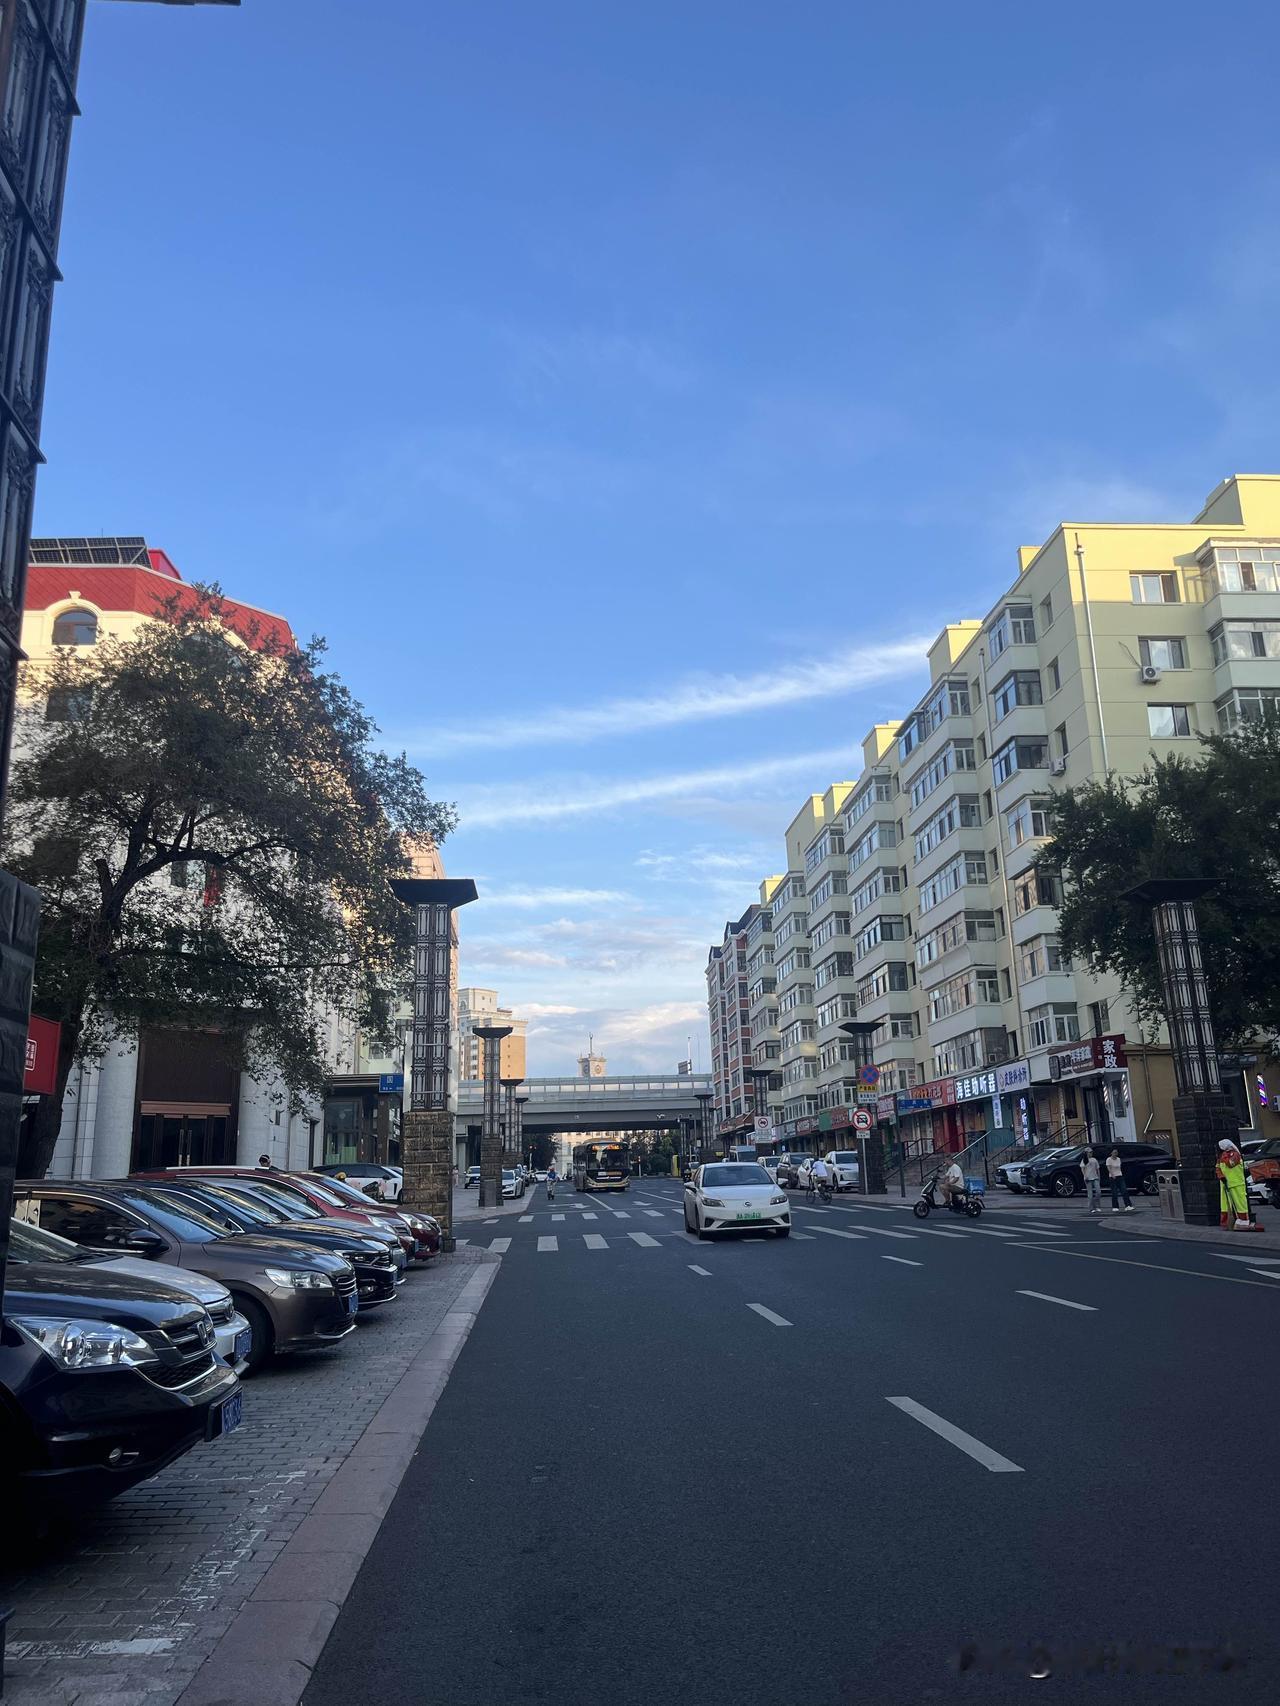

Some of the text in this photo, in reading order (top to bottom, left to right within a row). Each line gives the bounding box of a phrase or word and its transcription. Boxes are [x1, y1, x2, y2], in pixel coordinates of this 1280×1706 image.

[1102, 1039, 1118, 1068] 家政
[956, 1073, 996, 1100] 海佳助听器
[1019, 1097, 1030, 1141] 助听器
